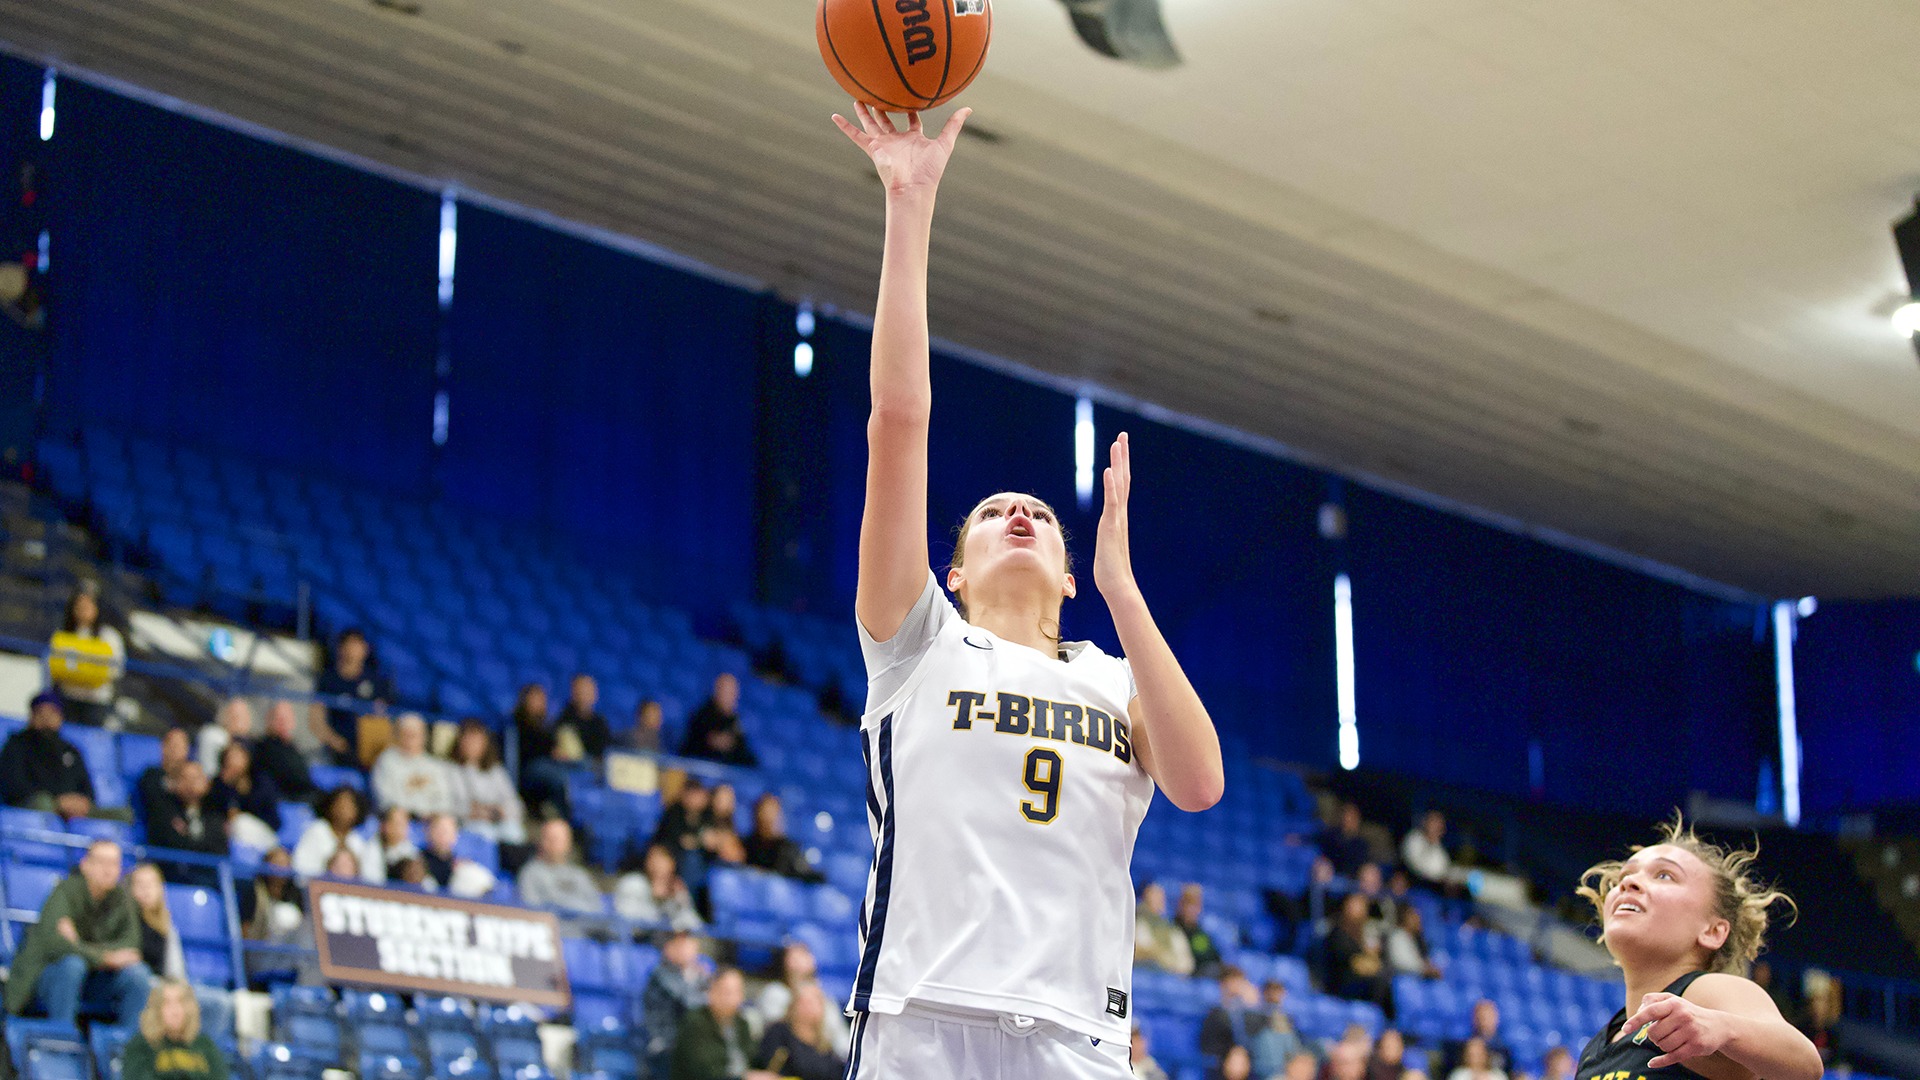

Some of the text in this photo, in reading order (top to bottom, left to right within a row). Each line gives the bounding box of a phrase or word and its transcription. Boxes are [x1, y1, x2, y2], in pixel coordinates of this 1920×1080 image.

[946, 690, 1132, 765] T-BIRDS
[1019, 745, 1064, 825] 9
[320, 892, 469, 949] STUDENT
[377, 936, 516, 987] SECTION
